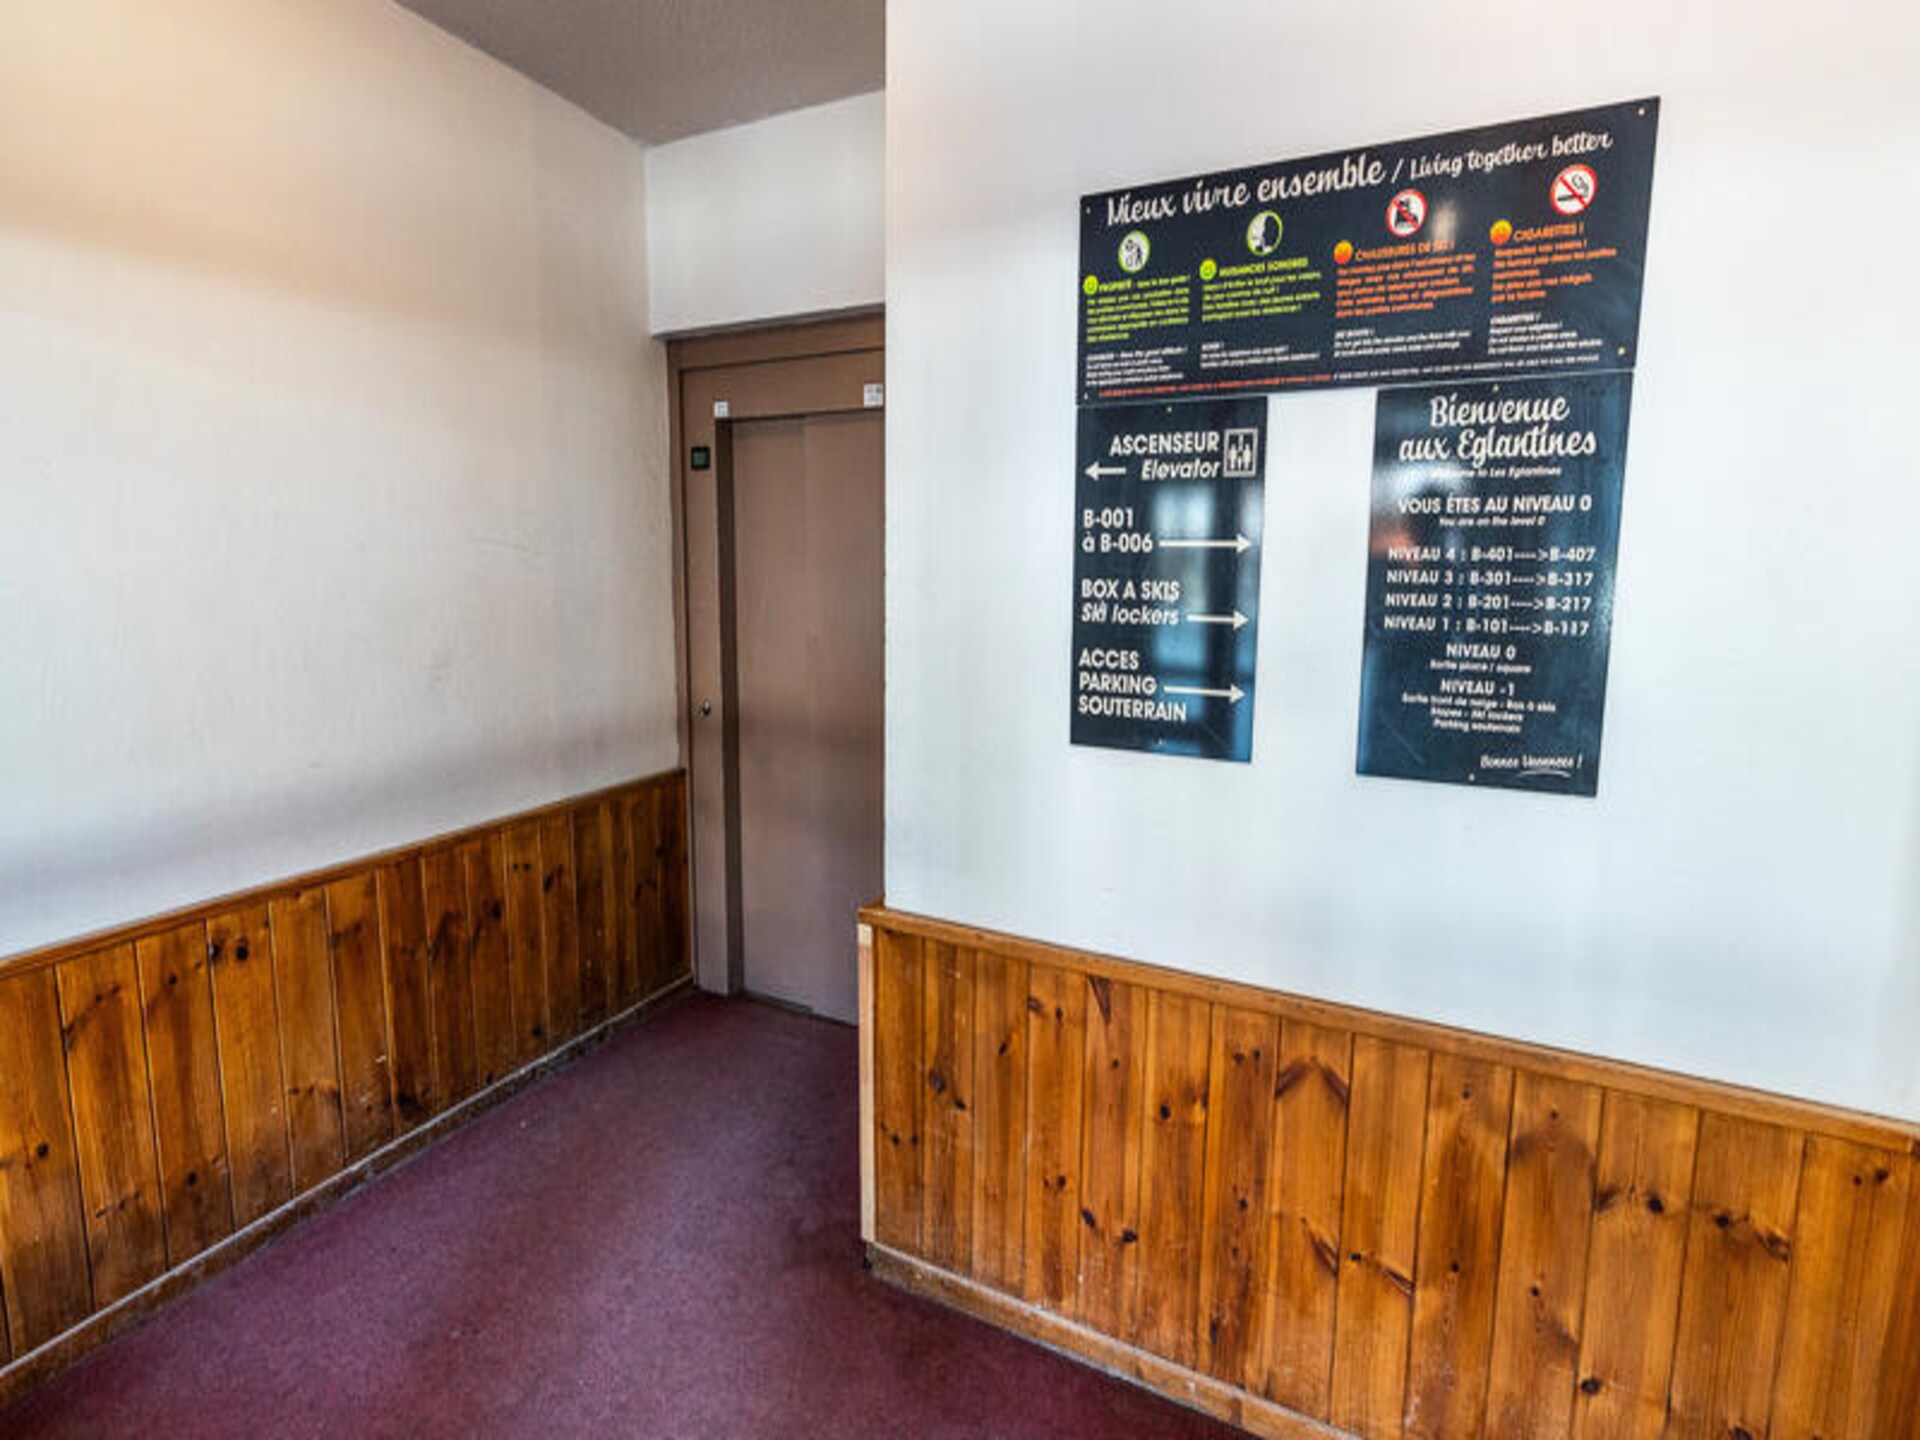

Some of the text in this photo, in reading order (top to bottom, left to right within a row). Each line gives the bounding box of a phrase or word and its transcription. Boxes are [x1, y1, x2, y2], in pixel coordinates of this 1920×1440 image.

[1106, 196, 1177, 226] Mieux
[1182, 180, 1251, 215] vivre
[1256, 153, 1387, 202] ensemble
[1410, 153, 1463, 180] Living
[1467, 141, 1547, 173] together
[1552, 131, 1614, 157] better
[1430, 392, 1571, 427] Bienvenue
[1109, 431, 1221, 456] ASCENSEUR
[1399, 423, 1597, 468] aux Eglantines
[1141, 458, 1221, 480] Elevator
[1399, 497, 1441, 514] VOUS
[1484, 497, 1509, 513] AU
[1513, 494, 1575, 512] NIVEAU
[1579, 494, 1592, 511] 0
[1083, 507, 1134, 529] B-001
[1082, 531, 1153, 553] à B-006
[1388, 546, 1441, 562] NIVEAU
[1445, 547, 1456, 562] 4
[1386, 570, 1439, 584] NIVEAU
[1443, 570, 1453, 584] 3
[1081, 578, 1180, 601] BOX A SKIS
[1385, 593, 1438, 608] NIVEAU
[1442, 594, 1452, 608] 2
[1081, 601, 1180, 625] Ski lockers
[1384, 616, 1436, 632] NIVEAU
[1442, 617, 1448, 631] 1
[1078, 648, 1140, 670] ACCES
[1446, 643, 1516, 660] NIVEAU 0
[1079, 671, 1157, 695] PARKING
[1440, 678, 1495, 695] NIVEAU
[1078, 695, 1187, 722] SOUTERRAIN
